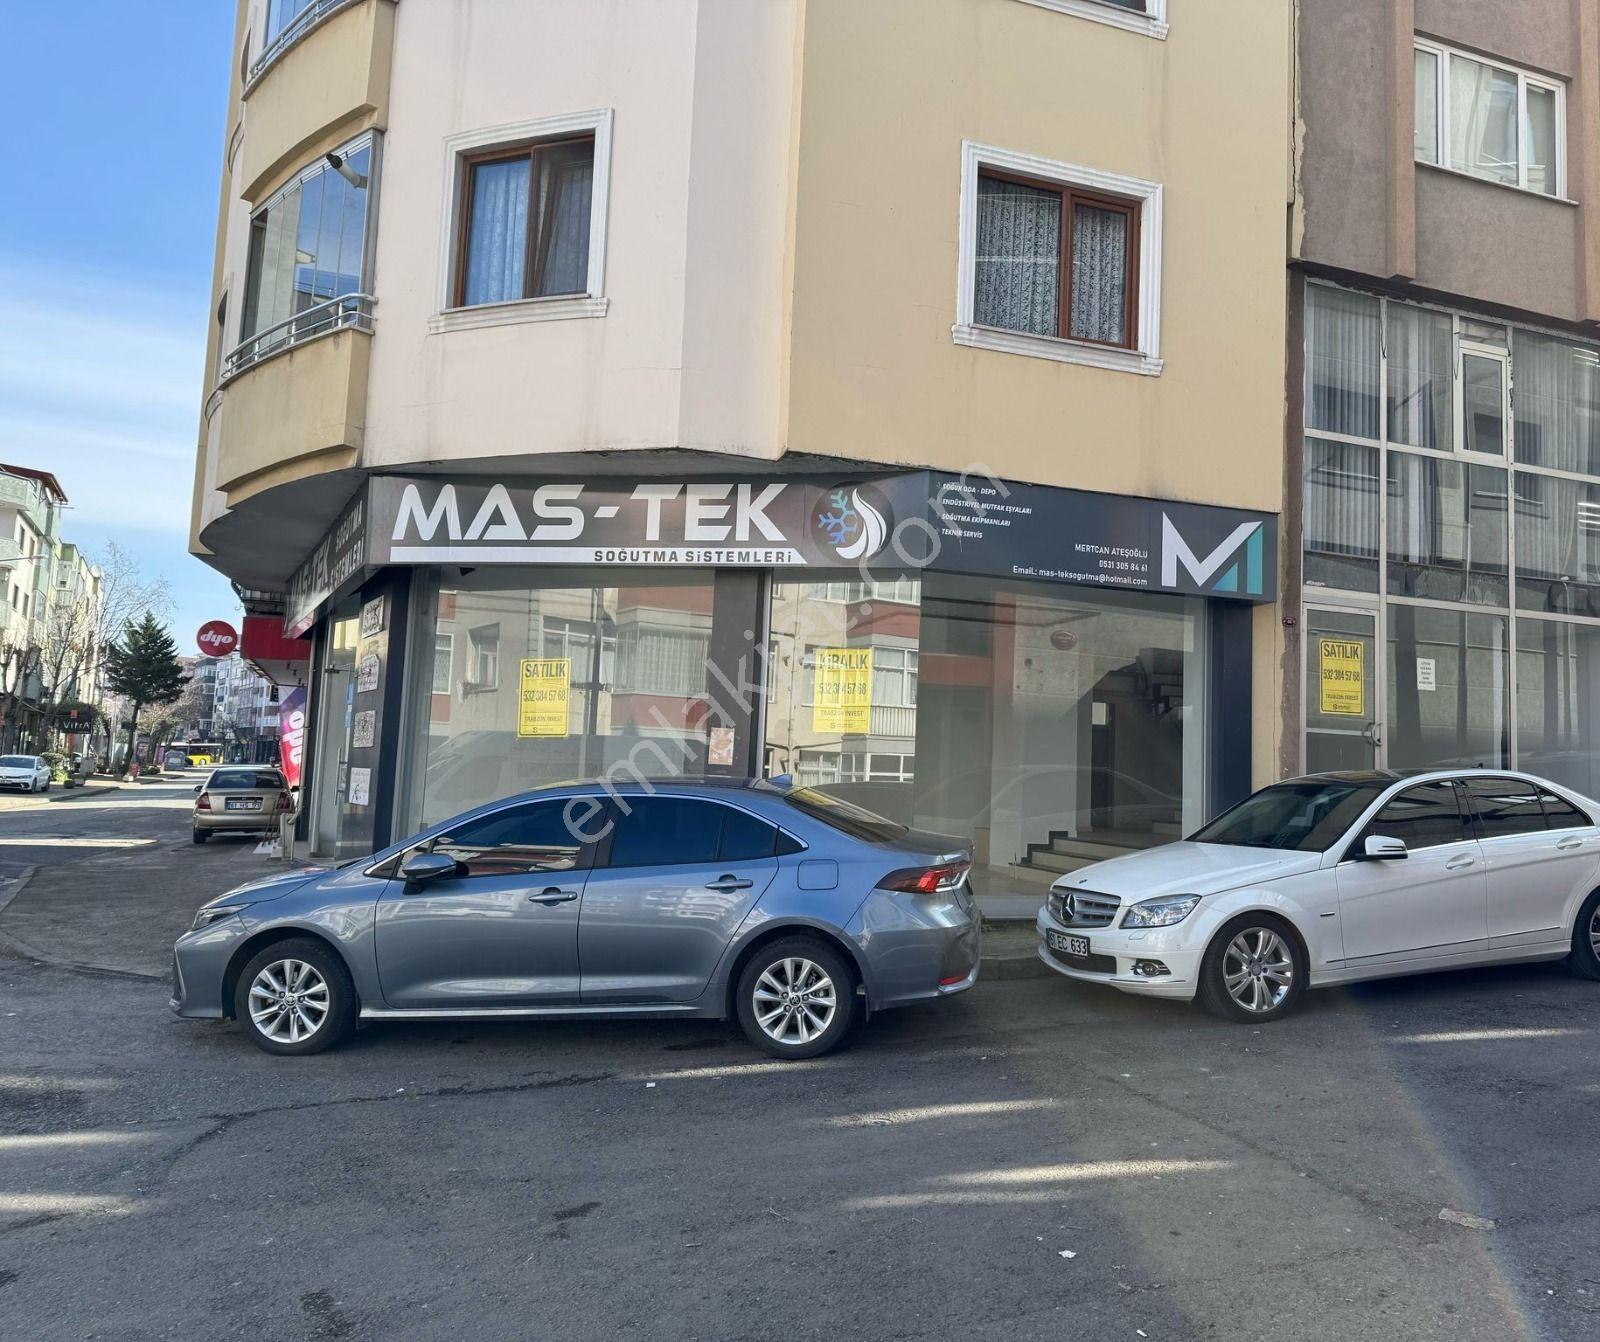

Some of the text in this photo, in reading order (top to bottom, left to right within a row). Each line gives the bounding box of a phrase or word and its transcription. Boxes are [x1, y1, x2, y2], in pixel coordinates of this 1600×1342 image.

[980, 487, 997, 496] DEPO
[391, 483, 788, 542] MAS-TEK
[981, 503, 1005, 512] MUTFAK
[594, 547, 678, 563] SOĞUTMA
[1075, 543, 1148, 559] MERTCAN ATEŞOĞLU
[1098, 560, 1148, 572] 0531 305 84 61
[200, 630, 234, 647] dyo
[1323, 643, 1360, 660] SATILIK
[525, 663, 566, 678] SATILIK
[1323, 668, 1333, 680] 532
[1345, 670, 1352, 681] 57
[523, 690, 535, 702] 532
[548, 690, 557, 701] 57
[847, 682, 856, 695] 57
[1057, 935, 1068, 950] EC
[1070, 938, 1087, 955] 633
